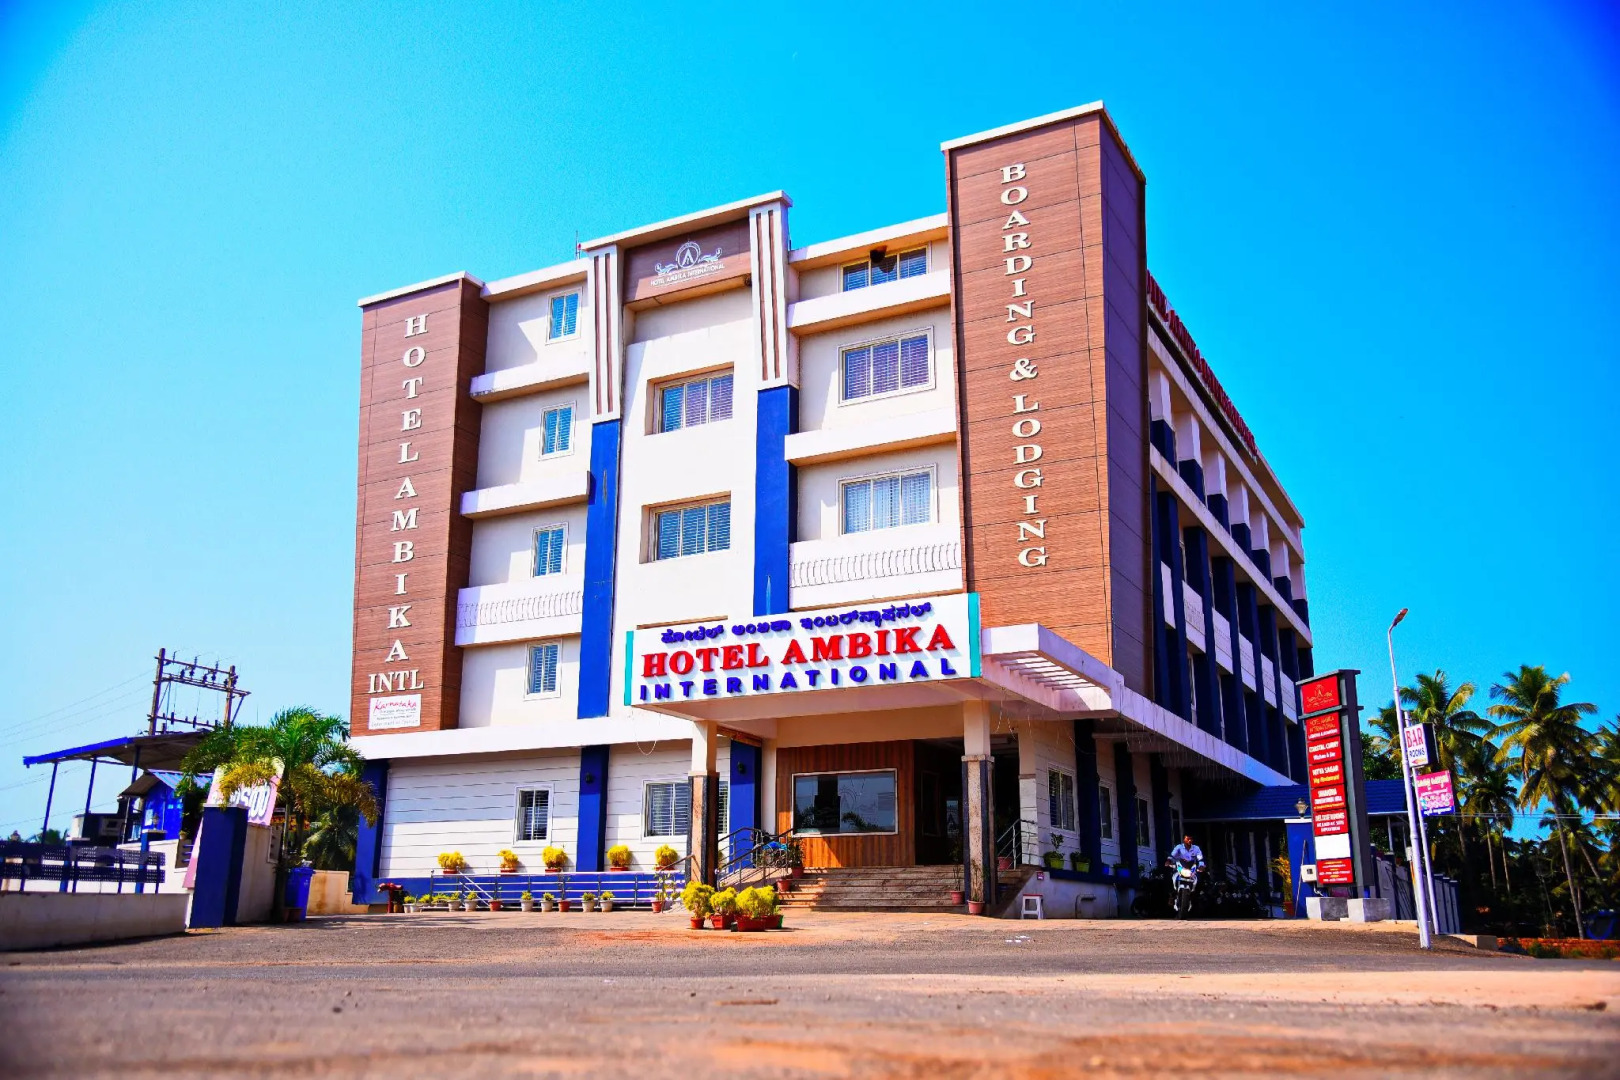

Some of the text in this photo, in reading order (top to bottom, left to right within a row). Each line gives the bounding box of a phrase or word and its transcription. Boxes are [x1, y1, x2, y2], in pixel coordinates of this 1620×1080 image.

[651, 278, 665, 286] HOTEL
[688, 264, 725, 277] INTERNATIONAL
[999, 163, 1049, 568] BOARDING & LODGING
[384, 313, 429, 662] HOTEL AMBIKA
[641, 624, 956, 677] HOTEL AMBIKA
[367, 669, 424, 694] INTL
[639, 658, 956, 700] INTERNATIONAL
[373, 699, 417, 713] Karnataka
[1406, 728, 1424, 748] BAR
[1409, 748, 1425, 757] ROOMS
